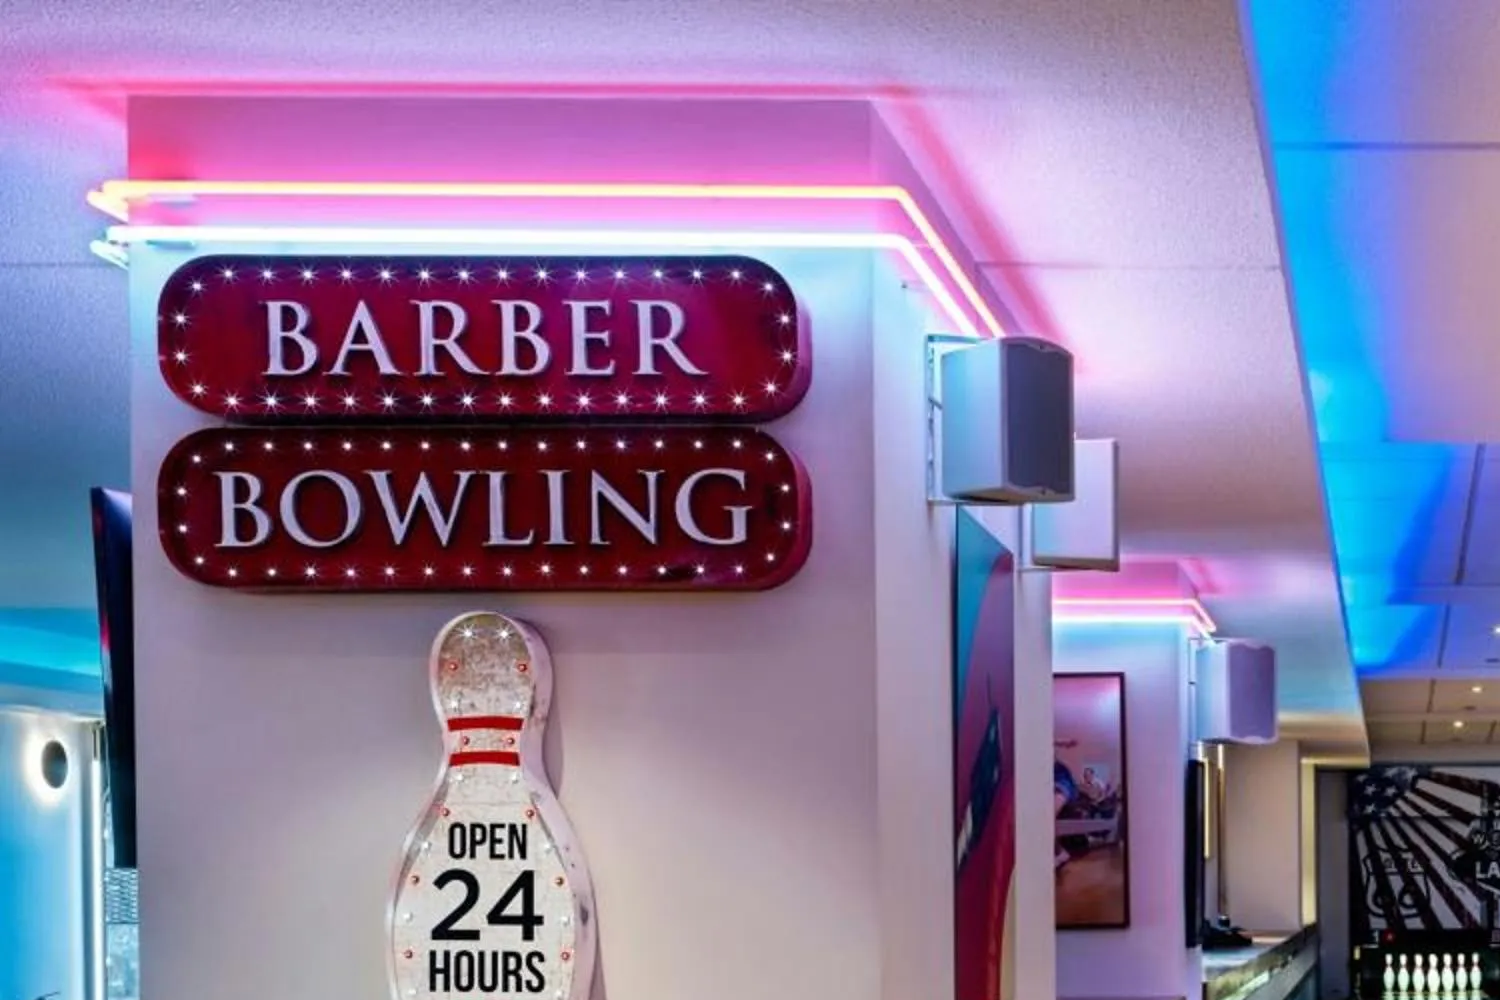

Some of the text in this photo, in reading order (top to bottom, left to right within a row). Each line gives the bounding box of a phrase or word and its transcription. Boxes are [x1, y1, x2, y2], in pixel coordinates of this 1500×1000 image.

[261, 299, 708, 376] BARBER
[213, 468, 754, 548] BOWLING
[447, 822, 528, 860] OPEN
[430, 869, 544, 942] 24
[429, 950, 546, 994] HOURS
